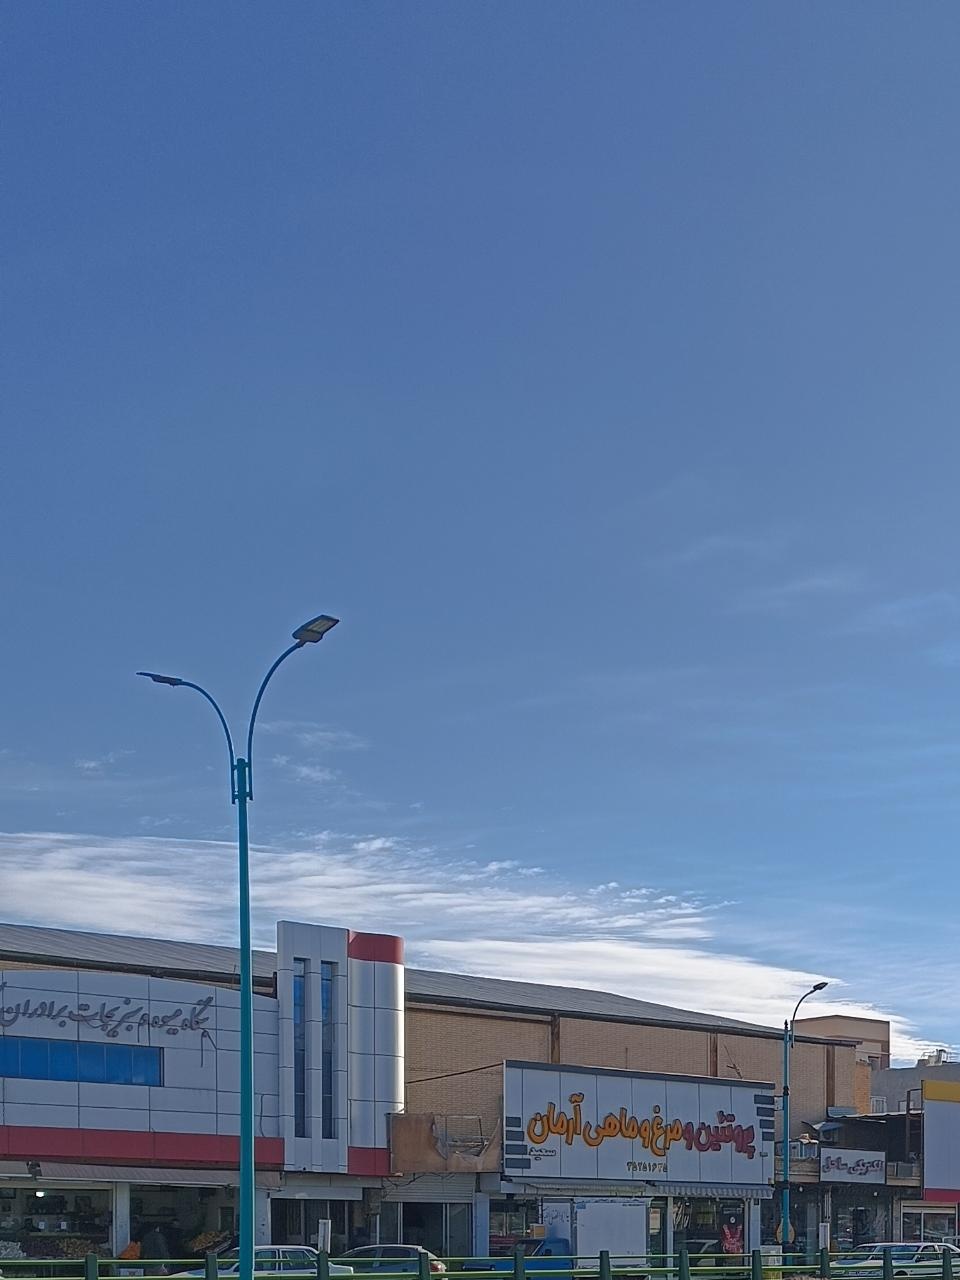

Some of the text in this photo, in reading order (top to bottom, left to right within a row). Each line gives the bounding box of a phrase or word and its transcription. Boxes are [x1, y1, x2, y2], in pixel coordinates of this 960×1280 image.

[0, 999, 68, 1028] برادران
[69, 998, 143, 1038] سبزیجات
[152, 1008, 183, 1035] میوه
[527, 1092, 584, 1146] آرمان
[583, 1107, 638, 1147] ماهی
[638, 1118, 650, 1149] و
[650, 1104, 682, 1157] مرغ
[683, 1121, 694, 1151] و
